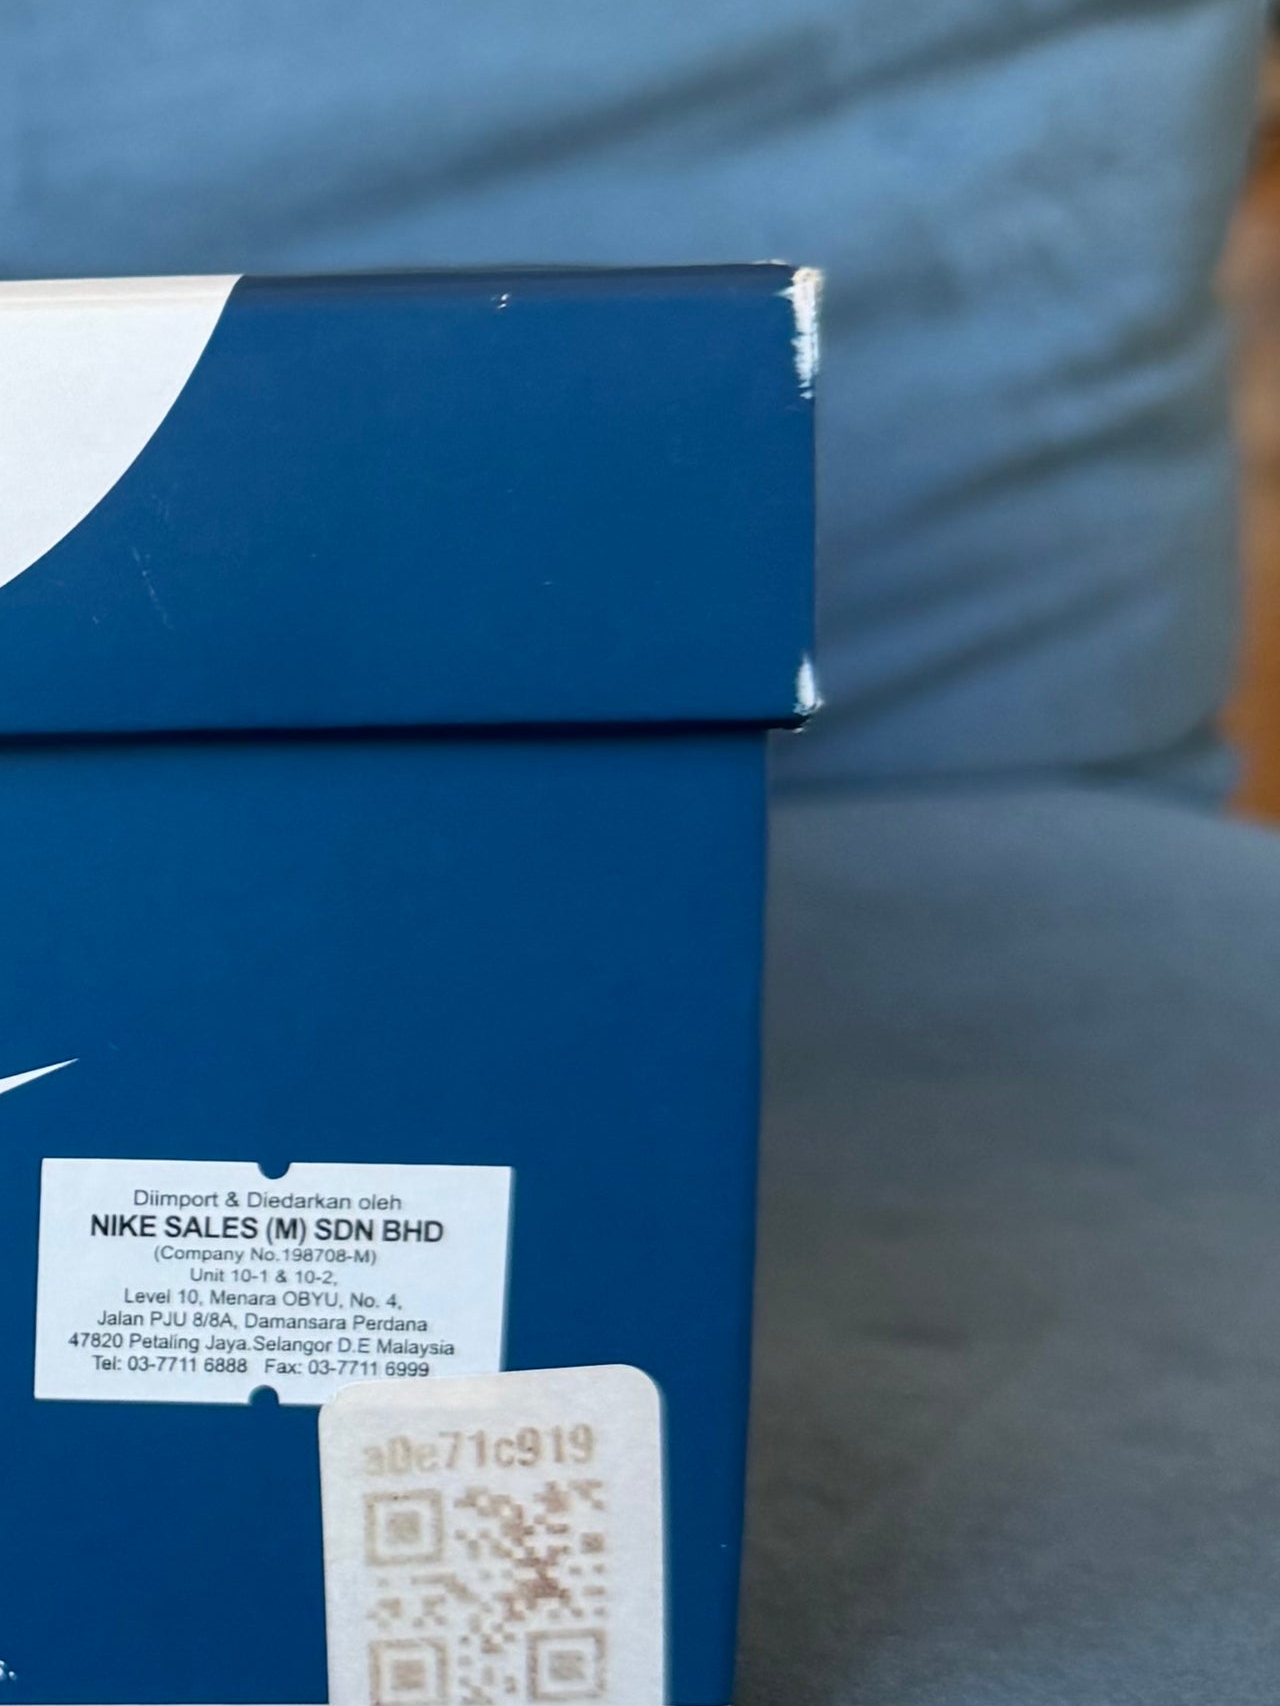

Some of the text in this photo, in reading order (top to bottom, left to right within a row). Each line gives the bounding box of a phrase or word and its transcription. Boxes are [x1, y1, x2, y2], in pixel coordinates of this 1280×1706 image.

[133, 1190, 402, 1211] Diimport & Diedarkan oleh
[90, 1215, 444, 1245] NIKE SALES (M) SDN BHD
[154, 1246, 242, 1264] (Company
[190, 1268, 338, 1287] Unit 10-1 & 10-2,
[124, 1289, 171, 1305] Level
[210, 1291, 276, 1307] Menara
[350, 1293, 380, 1309] No.
[97, 1311, 428, 1332] Jalan PJU 8/8A, Damansara Perdana
[68, 1333, 123, 1349] 47820
[128, 1334, 199, 1353] Petaling
[337, 1339, 370, 1354] D.E
[376, 1340, 455, 1358] Malaysia
[92, 1355, 429, 1377] Tel: 03-7711 6888 Fax: 03-7711 6999
